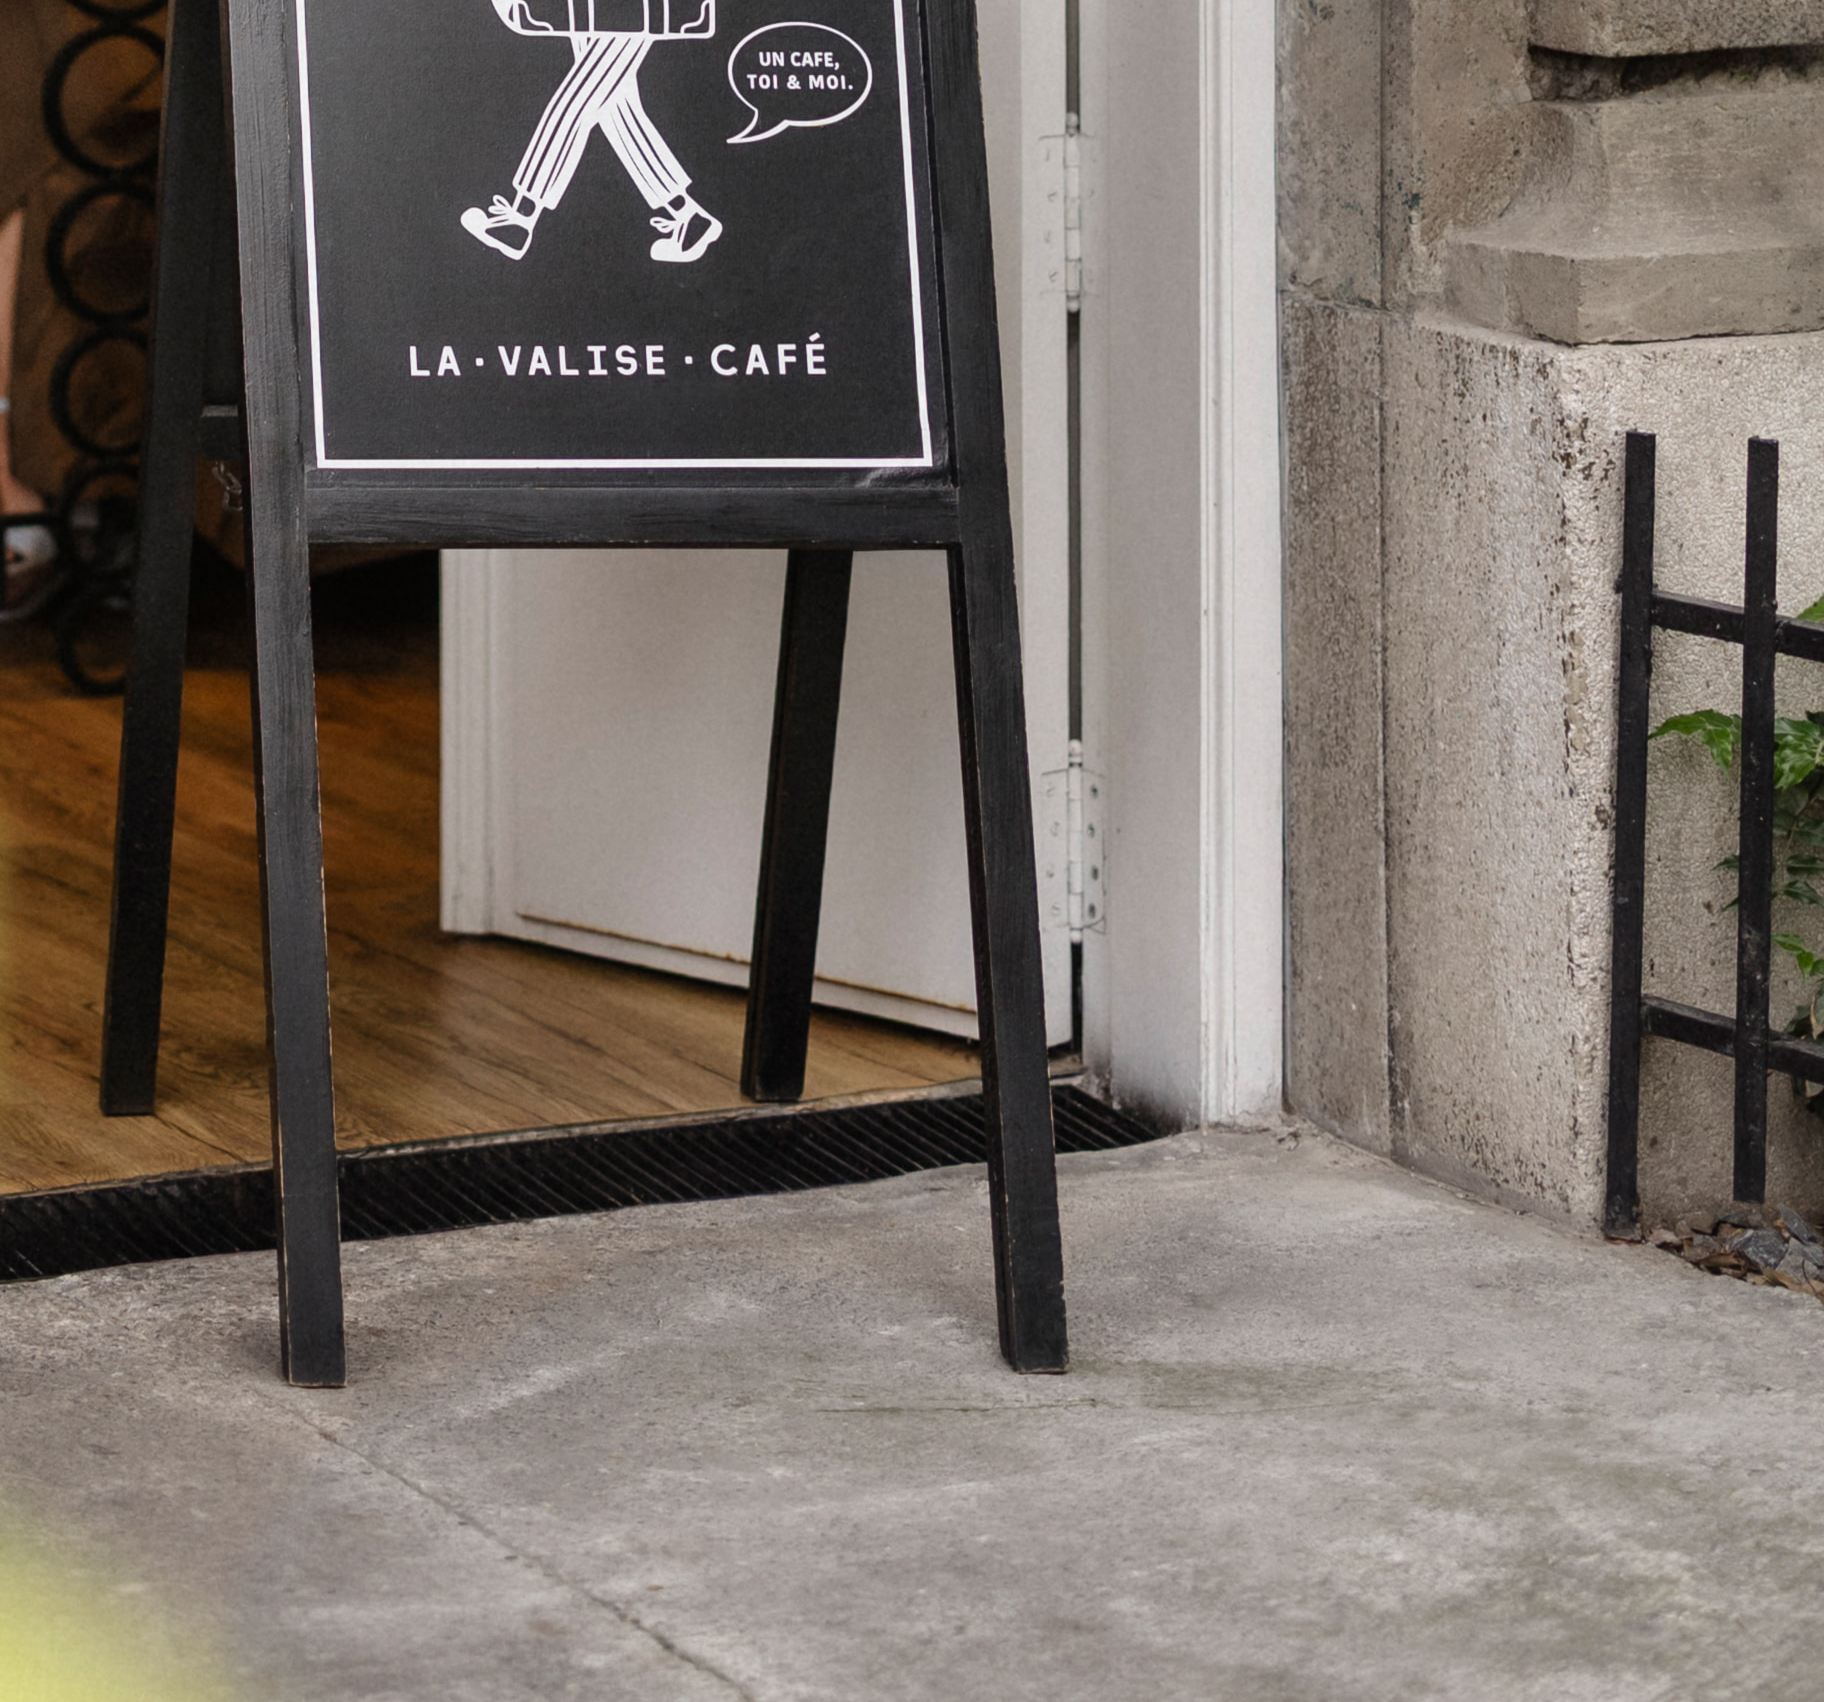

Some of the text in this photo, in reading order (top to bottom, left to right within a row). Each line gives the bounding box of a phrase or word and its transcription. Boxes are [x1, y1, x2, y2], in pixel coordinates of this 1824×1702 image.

[758, 51, 840, 71] UN CAFE,
[746, 74, 854, 91] TOI & MOI.
[409, 331, 827, 377] LA VALISE CAFÉ
